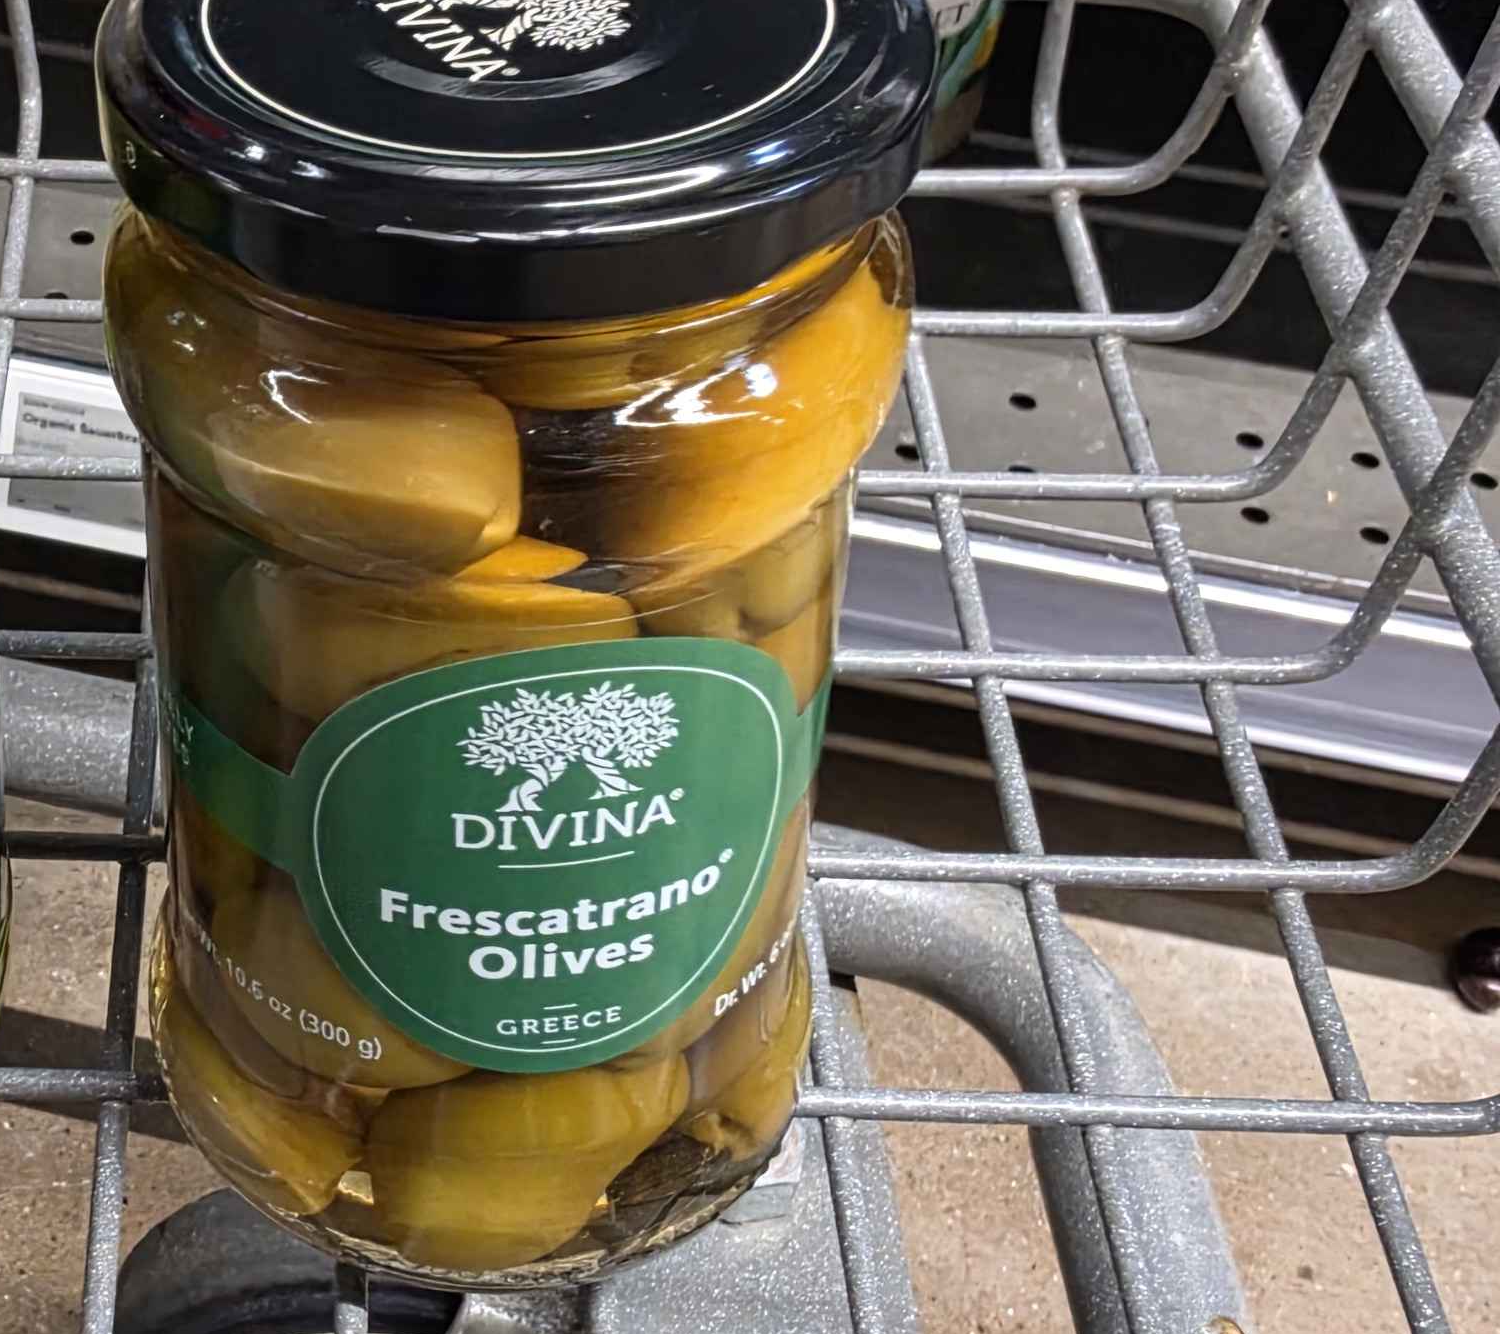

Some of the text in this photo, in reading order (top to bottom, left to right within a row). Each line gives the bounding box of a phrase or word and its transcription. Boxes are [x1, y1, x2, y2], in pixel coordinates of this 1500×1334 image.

[451, 794, 676, 851] DIVINA
[380, 865, 722, 938] Frescatrano
[468, 933, 655, 980] Olives
[268, 996, 293, 1021] oz
[299, 1008, 351, 1048] (300
[357, 1036, 384, 1061] g)
[496, 1005, 622, 1036] GREECE
[714, 988, 739, 1018] Dr.
